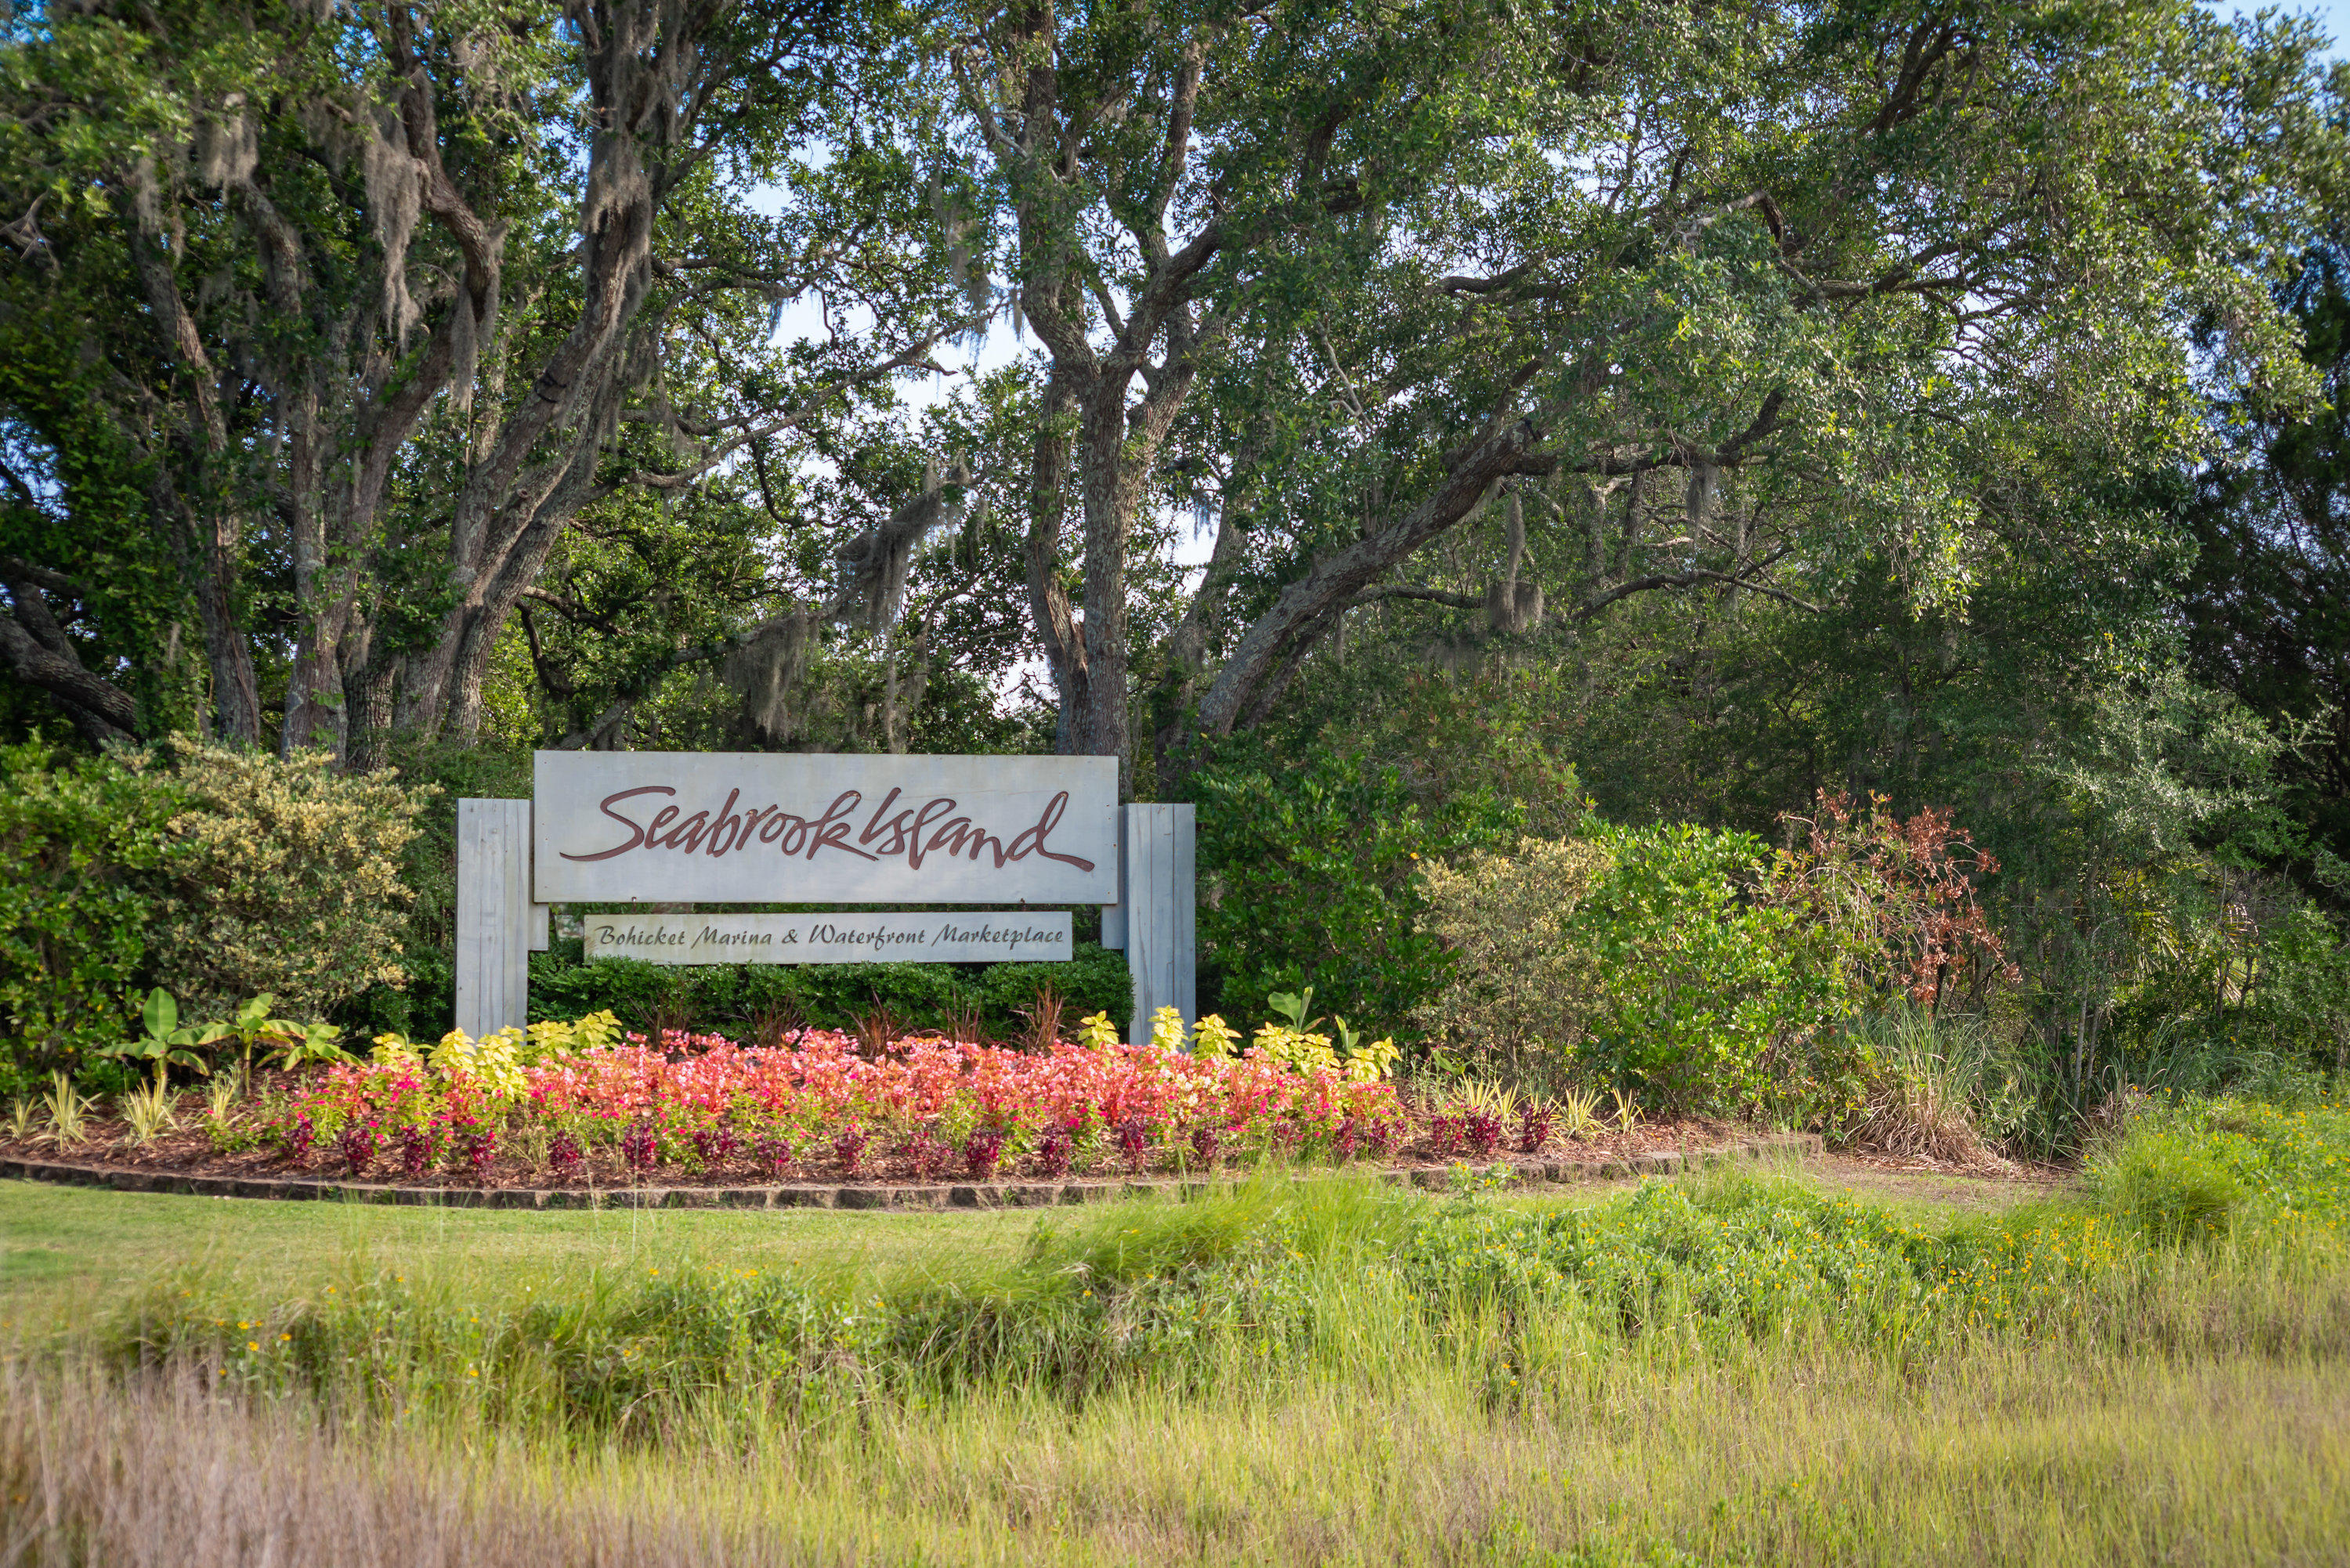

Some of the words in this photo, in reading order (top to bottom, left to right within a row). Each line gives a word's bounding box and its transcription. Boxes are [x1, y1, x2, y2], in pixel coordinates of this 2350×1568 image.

[559, 786, 879, 862] Seabrook
[859, 786, 1095, 873] Island
[594, 925, 685, 945] Bohicket
[691, 926, 772, 949] Marina
[781, 929, 799, 945] &
[808, 924, 926, 951] Waterfront
[931, 924, 1064, 951] Marketplace
